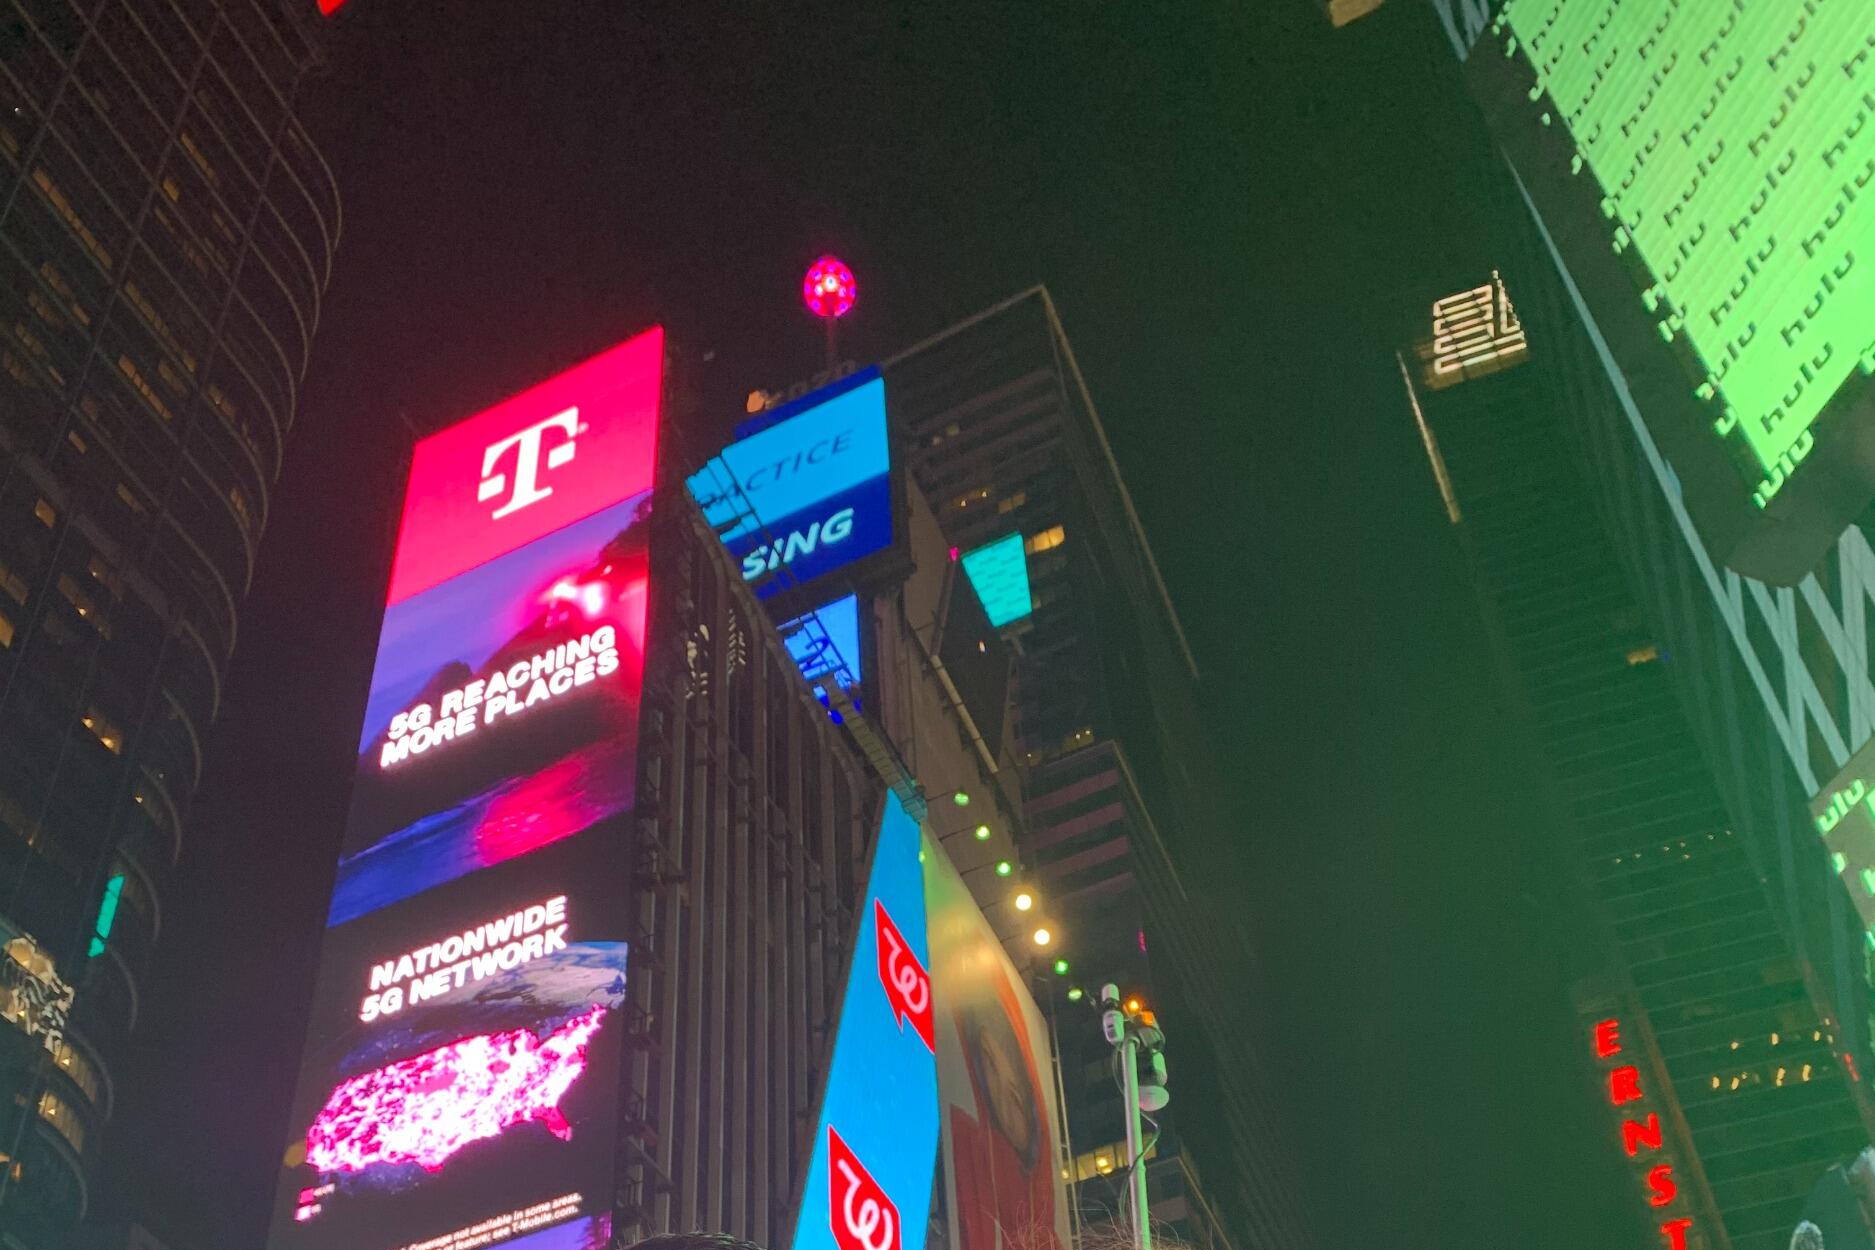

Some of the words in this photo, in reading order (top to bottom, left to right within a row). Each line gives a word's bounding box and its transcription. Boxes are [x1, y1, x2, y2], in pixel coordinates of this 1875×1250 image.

[1621, 51, 1676, 138] hulu
[1681, 55, 1743, 148] hulu
[1748, 61, 1815, 158] hulu
[1663, 138, 1725, 229] hulu
[1728, 148, 1797, 243] hulu
[1800, 158, 1875, 260] hulu
[1709, 233, 1777, 327] hulu
[1779, 248, 1856, 348] hulu
[1760, 341, 1834, 436] hulu
[477, 405, 580, 521] T
[742, 507, 854, 582] SING
[379, 706, 478, 768] MORE
[484, 648, 619, 725] PLACES
[387, 703, 433, 740] 5G
[439, 625, 616, 718] REACHING
[359, 987, 404, 1022] 5G
[408, 923, 569, 1005] NETWORK
[369, 895, 568, 991] NATIONWIDE
